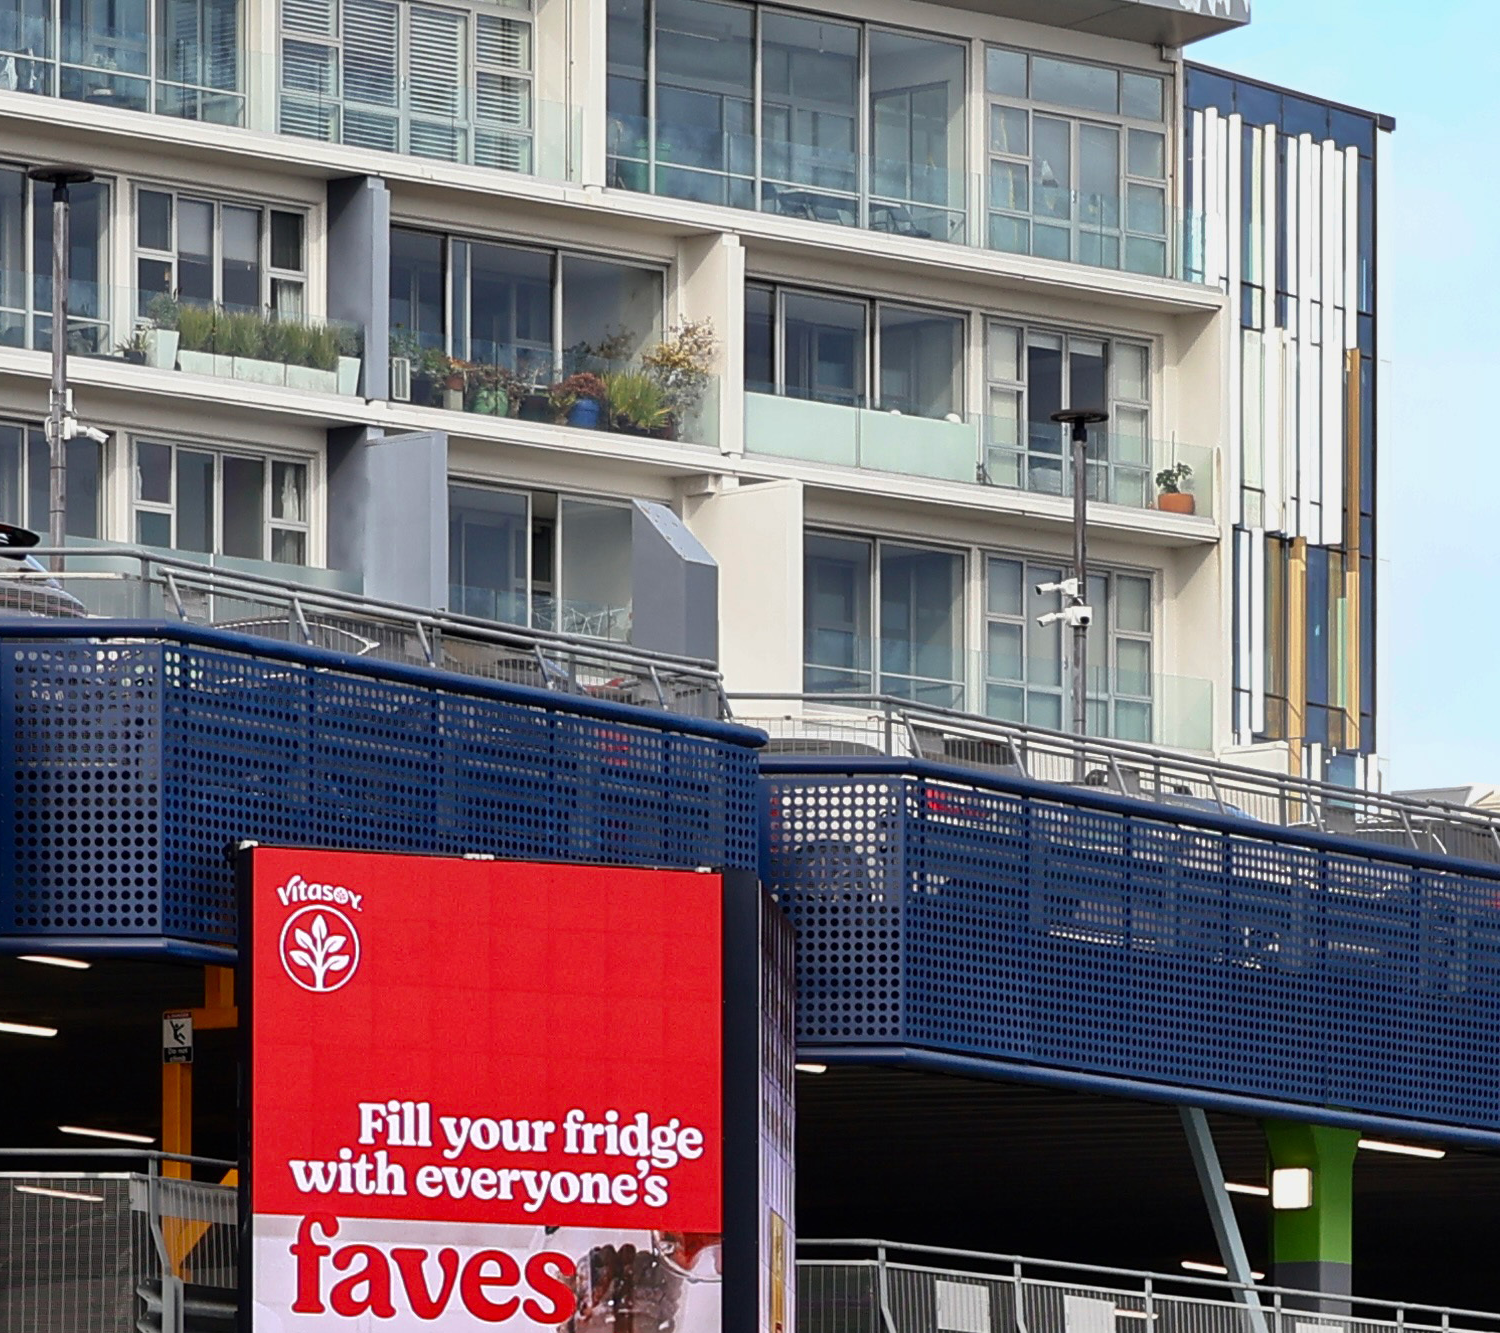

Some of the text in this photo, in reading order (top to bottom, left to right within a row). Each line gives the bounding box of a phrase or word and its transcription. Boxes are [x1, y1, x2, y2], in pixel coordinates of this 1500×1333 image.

[358, 1100, 704, 1169] Fill your fridge
[289, 1149, 669, 1211] with everyone's
[288, 1211, 578, 1325] faves
